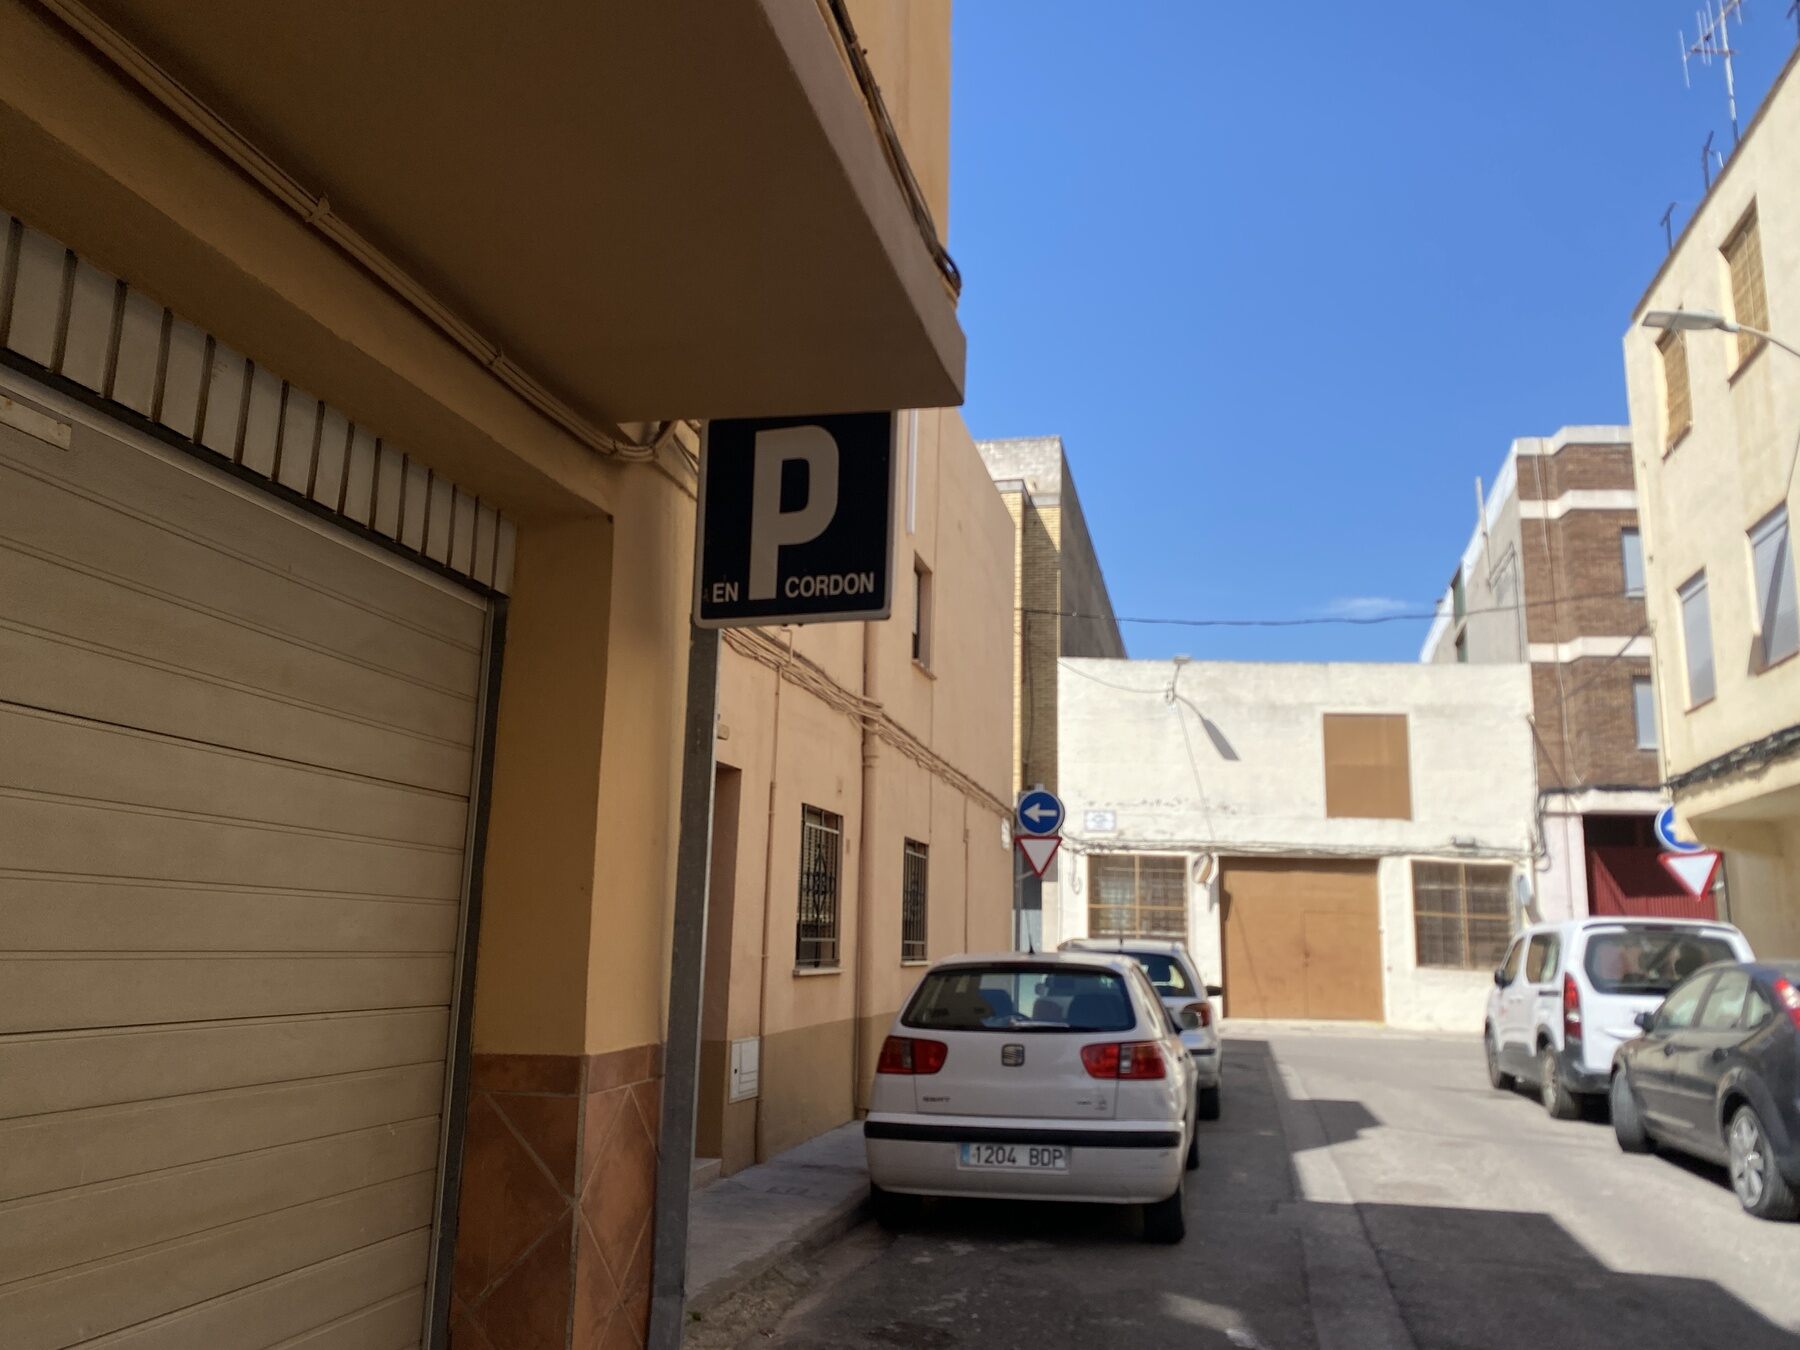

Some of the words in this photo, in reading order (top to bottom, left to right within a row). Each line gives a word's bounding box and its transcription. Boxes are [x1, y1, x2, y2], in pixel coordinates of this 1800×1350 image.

[748, 424, 840, 601] P
[712, 581, 739, 603] EN
[784, 572, 875, 599] CORDON
[976, 1145, 1017, 1165] 1204
[1029, 1147, 1063, 1168] BDP
